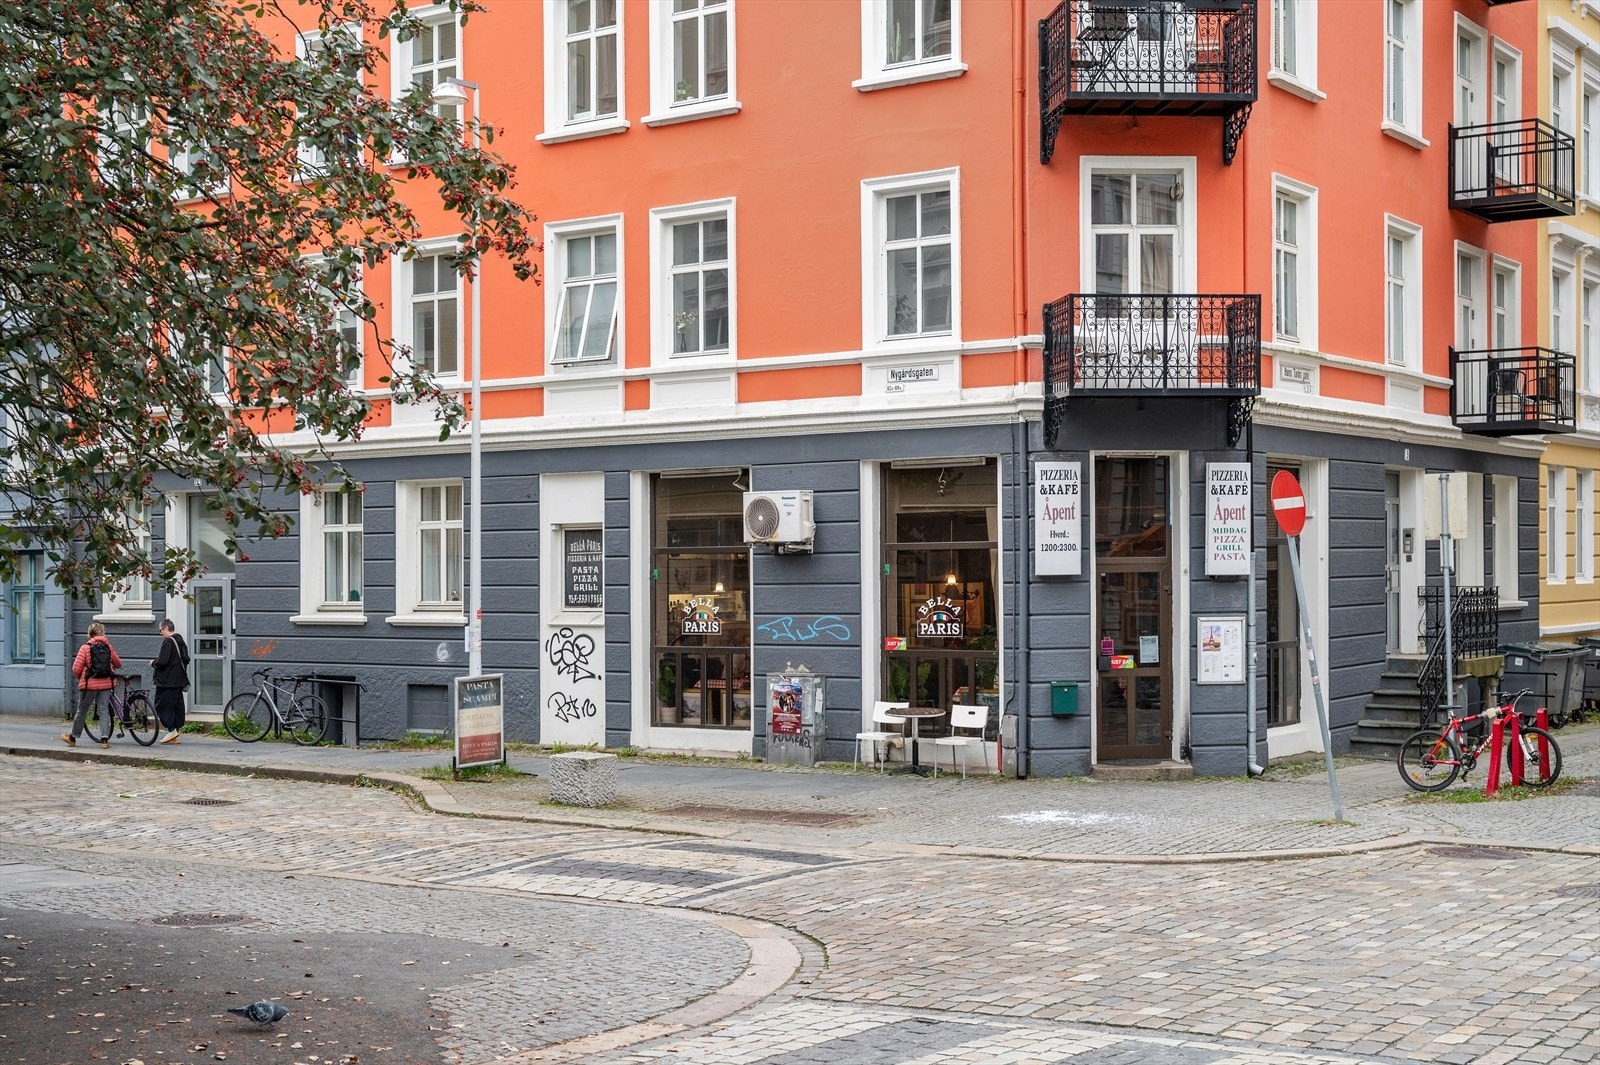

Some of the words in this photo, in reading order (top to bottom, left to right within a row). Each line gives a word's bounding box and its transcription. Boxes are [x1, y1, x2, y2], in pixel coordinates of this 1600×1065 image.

[890, 368, 934, 380] Nygårdsgaten
[1040, 469, 1079, 481] PIZZERIA
[1211, 470, 1248, 481] PIZZERIA
[1040, 481, 1079, 495] &KAFÉ
[1211, 482, 1249, 496] &KAFÉ
[1042, 497, 1076, 525] Åpent
[1213, 497, 1246, 525] Åpent
[1214, 535, 1245, 544] PIZZA
[570, 540, 586, 552] BELLA
[586, 540, 601, 552] PARIS
[1214, 552, 1246, 561] PASTA
[572, 566, 599, 574] PASTA
[573, 575, 598, 583] PIZZA
[573, 584, 598, 592] GRILL
[683, 598, 720, 615] BELLA
[919, 597, 962, 616] BELLA
[684, 621, 719, 633] PARIS
[920, 622, 960, 635] PARIS
[466, 681, 494, 691] PASTA
[463, 693, 497, 704] SCAMPI
